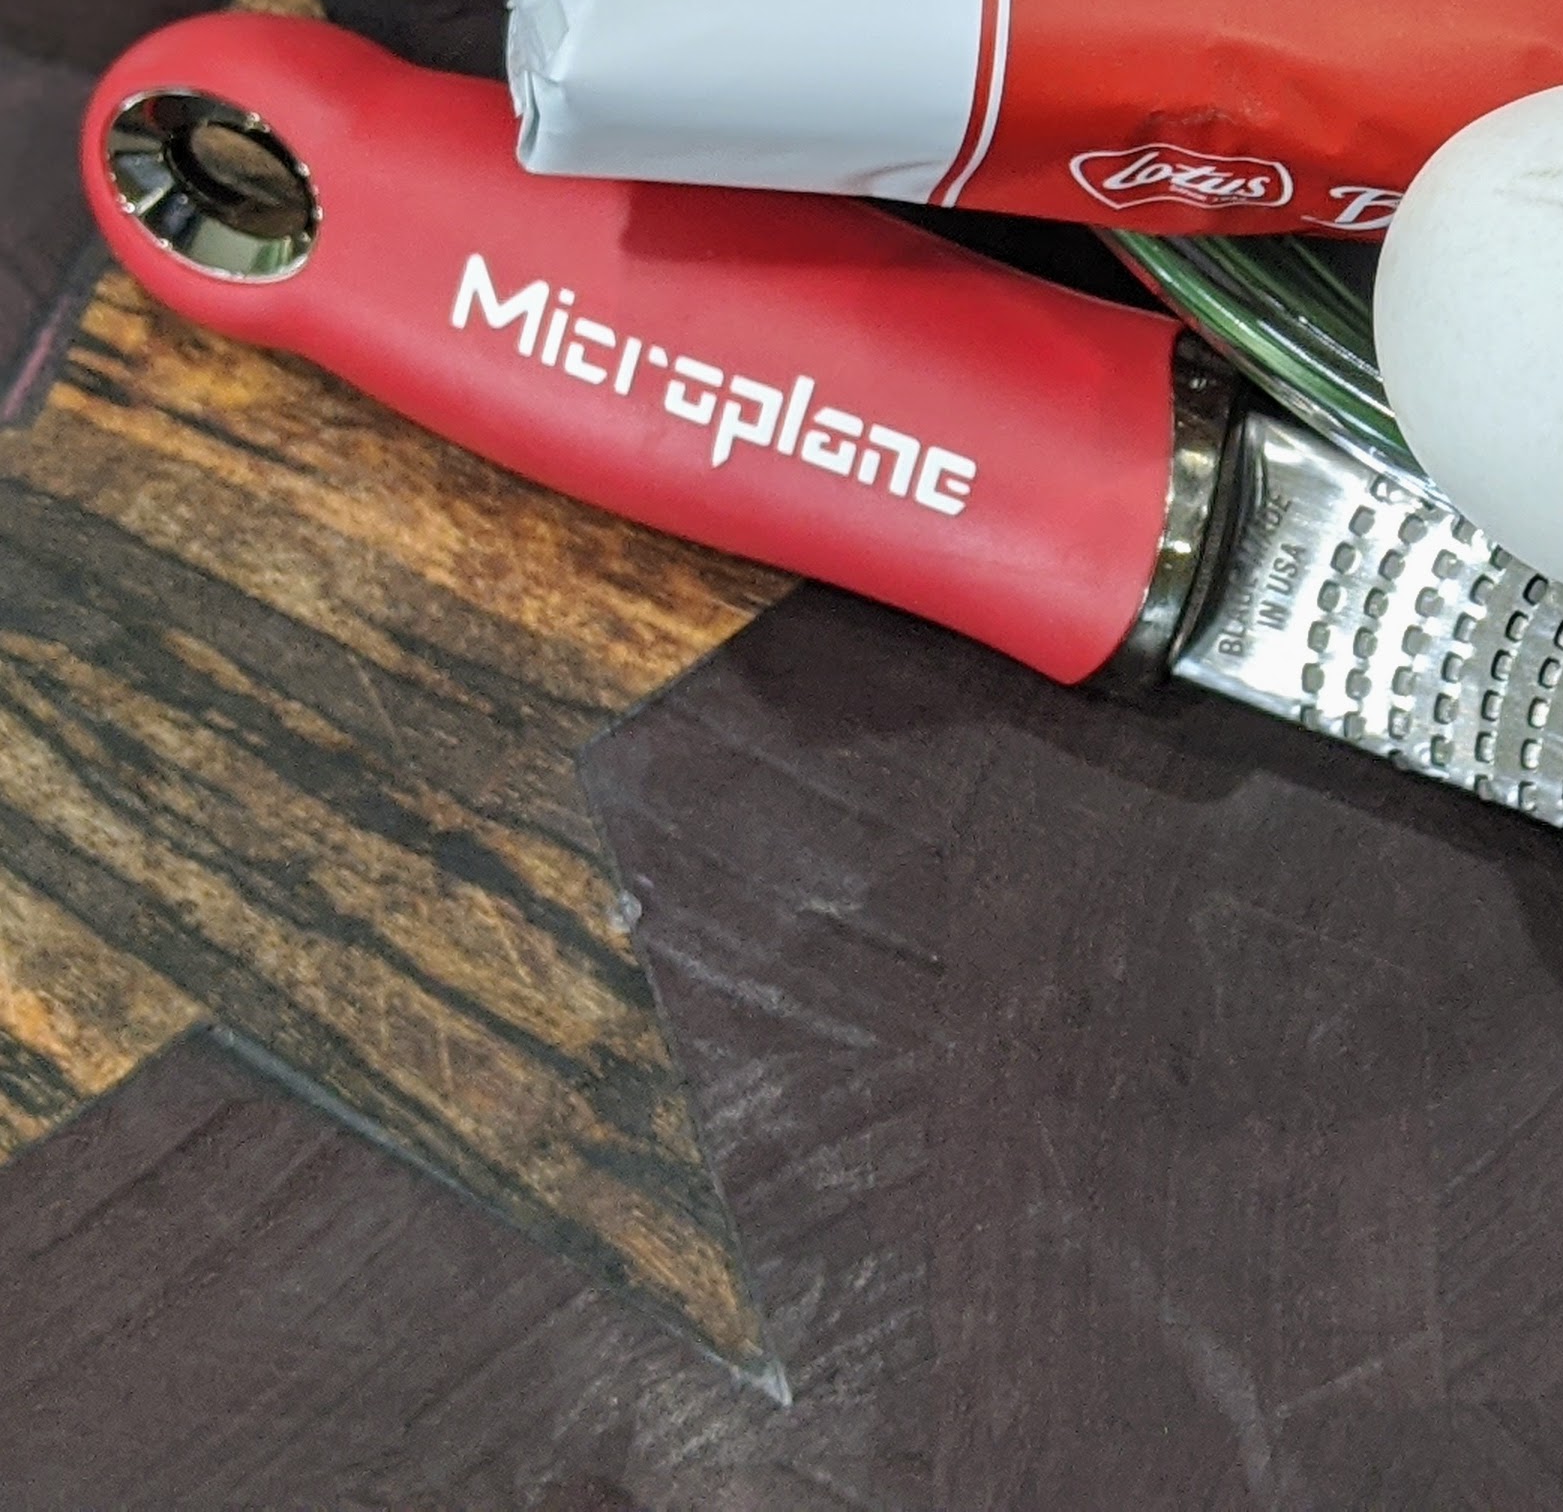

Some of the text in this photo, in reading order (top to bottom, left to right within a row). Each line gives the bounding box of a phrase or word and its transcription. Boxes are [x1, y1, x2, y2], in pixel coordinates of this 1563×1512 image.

[1101, 149, 1273, 200] Lotus
[449, 251, 979, 518] Microplane
[1256, 542, 1307, 632] IN USA
